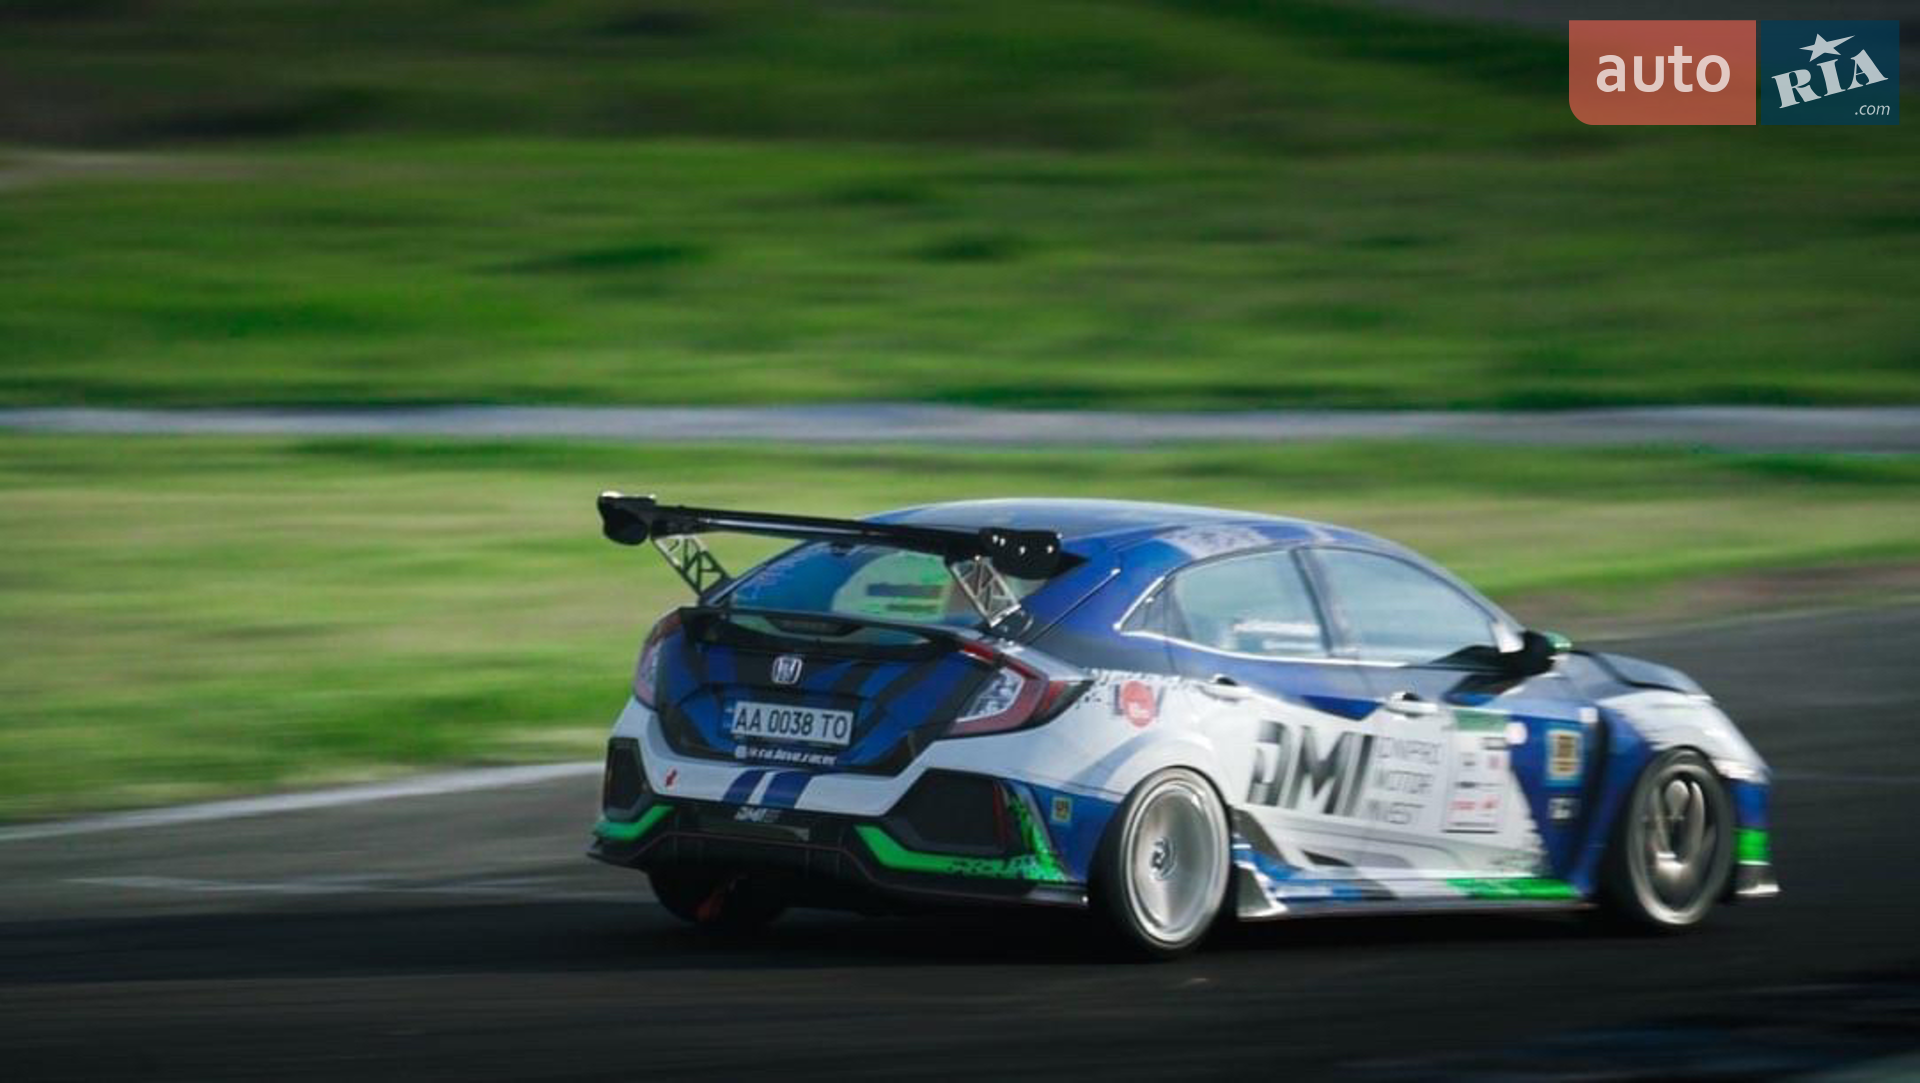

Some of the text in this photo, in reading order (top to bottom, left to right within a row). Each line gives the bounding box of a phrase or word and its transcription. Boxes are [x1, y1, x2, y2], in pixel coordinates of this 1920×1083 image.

[735, 707, 849, 739] AA 0038 TO
